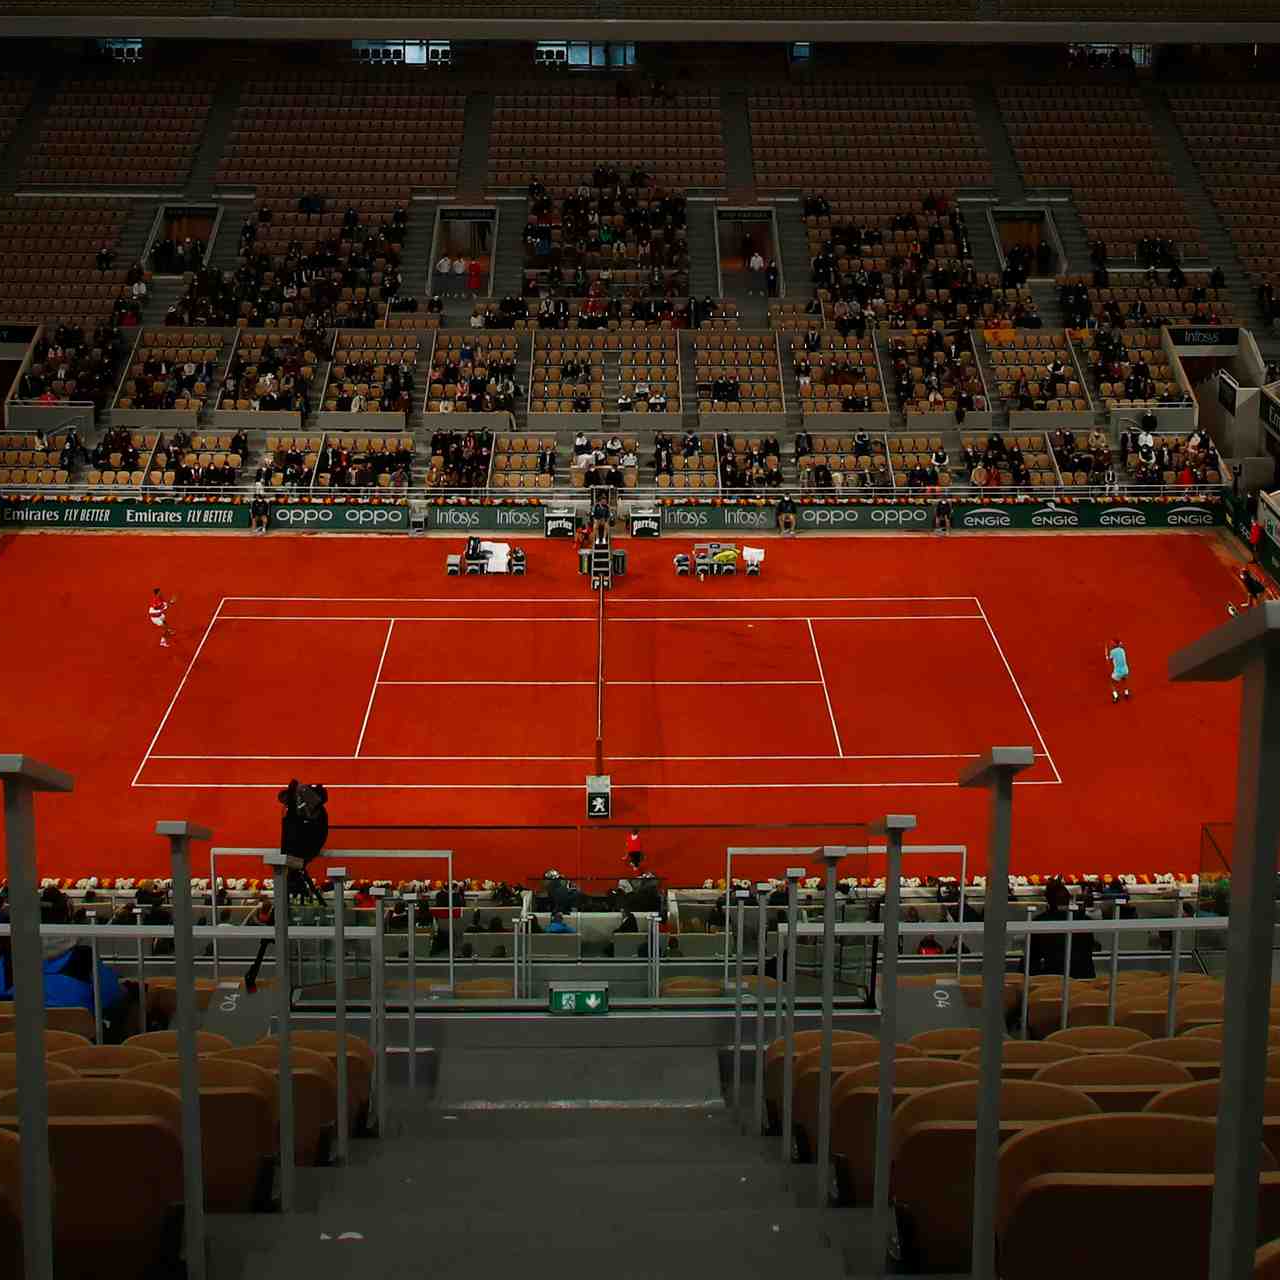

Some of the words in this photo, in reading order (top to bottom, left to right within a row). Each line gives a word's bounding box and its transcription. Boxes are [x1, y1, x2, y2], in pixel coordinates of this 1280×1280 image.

[4, 507, 60, 521] Emirates
[63, 509, 80, 521] FLY
[80, 509, 112, 522] BETTER
[126, 508, 183, 522] Emirates
[186, 510, 202, 523] FLY
[202, 510, 233, 523] BETTER
[276, 509, 333, 524] oppo
[345, 509, 402, 525] oppo
[436, 508, 480, 527] Infosys
[496, 508, 540, 527] Infosys
[664, 509, 709, 528] Infosys
[725, 509, 768, 528] Infosys
[802, 509, 858, 524] oppo
[871, 509, 927, 524] oppo
[221, 991, 240, 1012] 04
